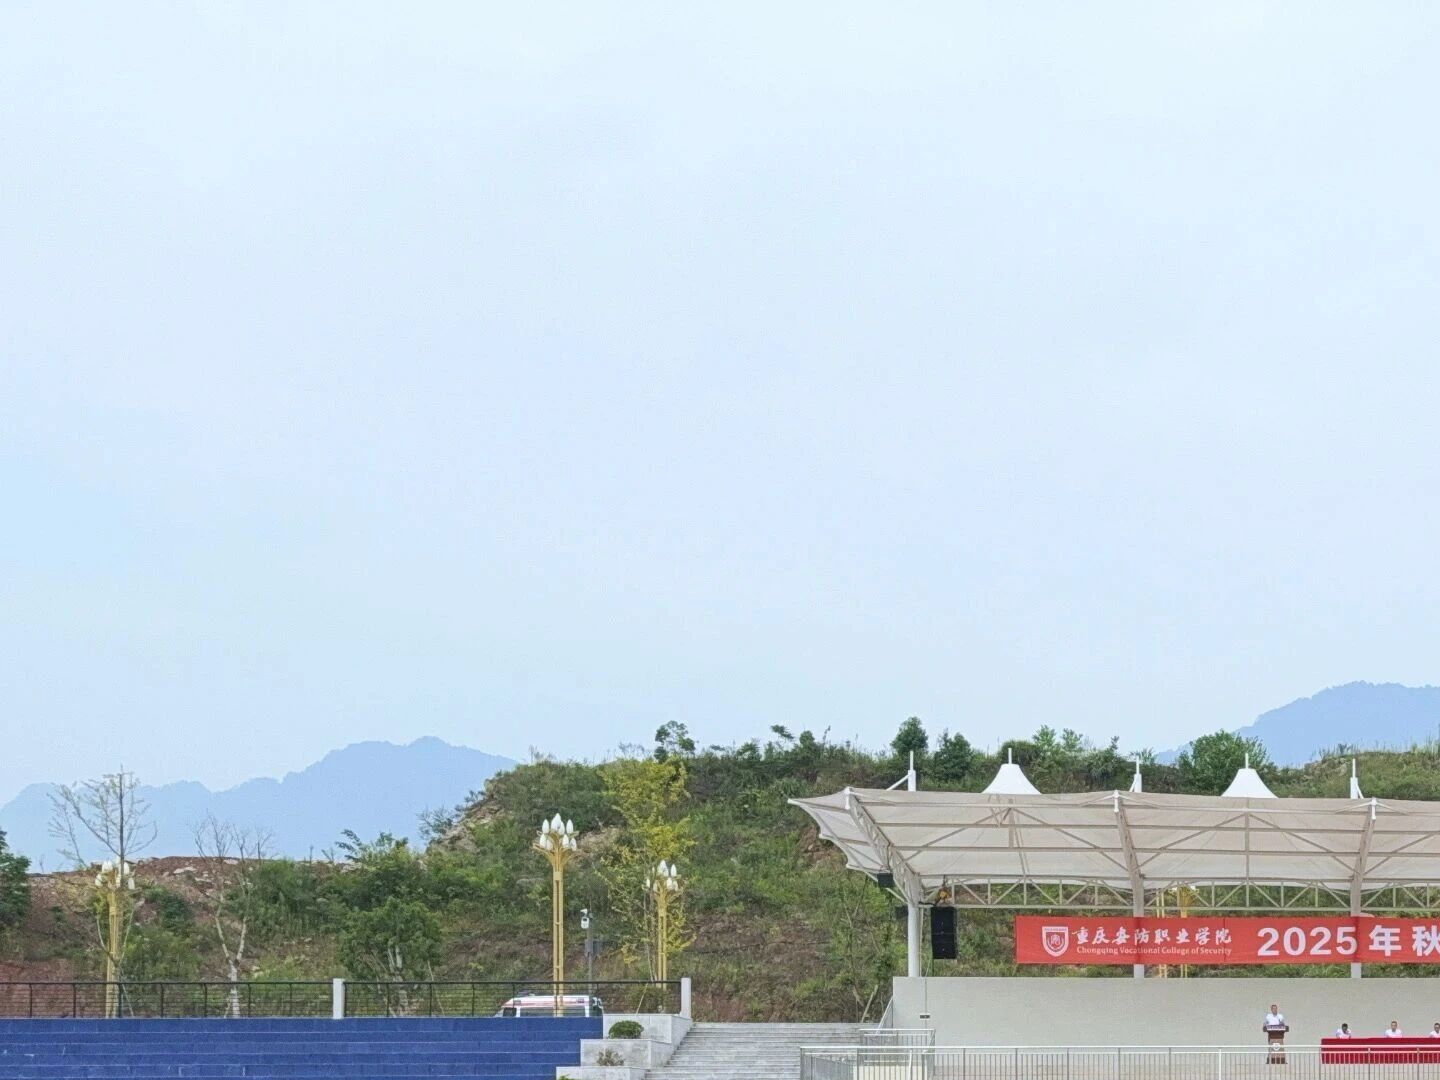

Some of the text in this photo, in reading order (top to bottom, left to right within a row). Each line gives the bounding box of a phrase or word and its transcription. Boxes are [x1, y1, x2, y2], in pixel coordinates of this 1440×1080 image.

[1072, 926, 1232, 945] 重庆安防职业学院
[1076, 946, 1232, 957] Chongqing Vocational College of Security
